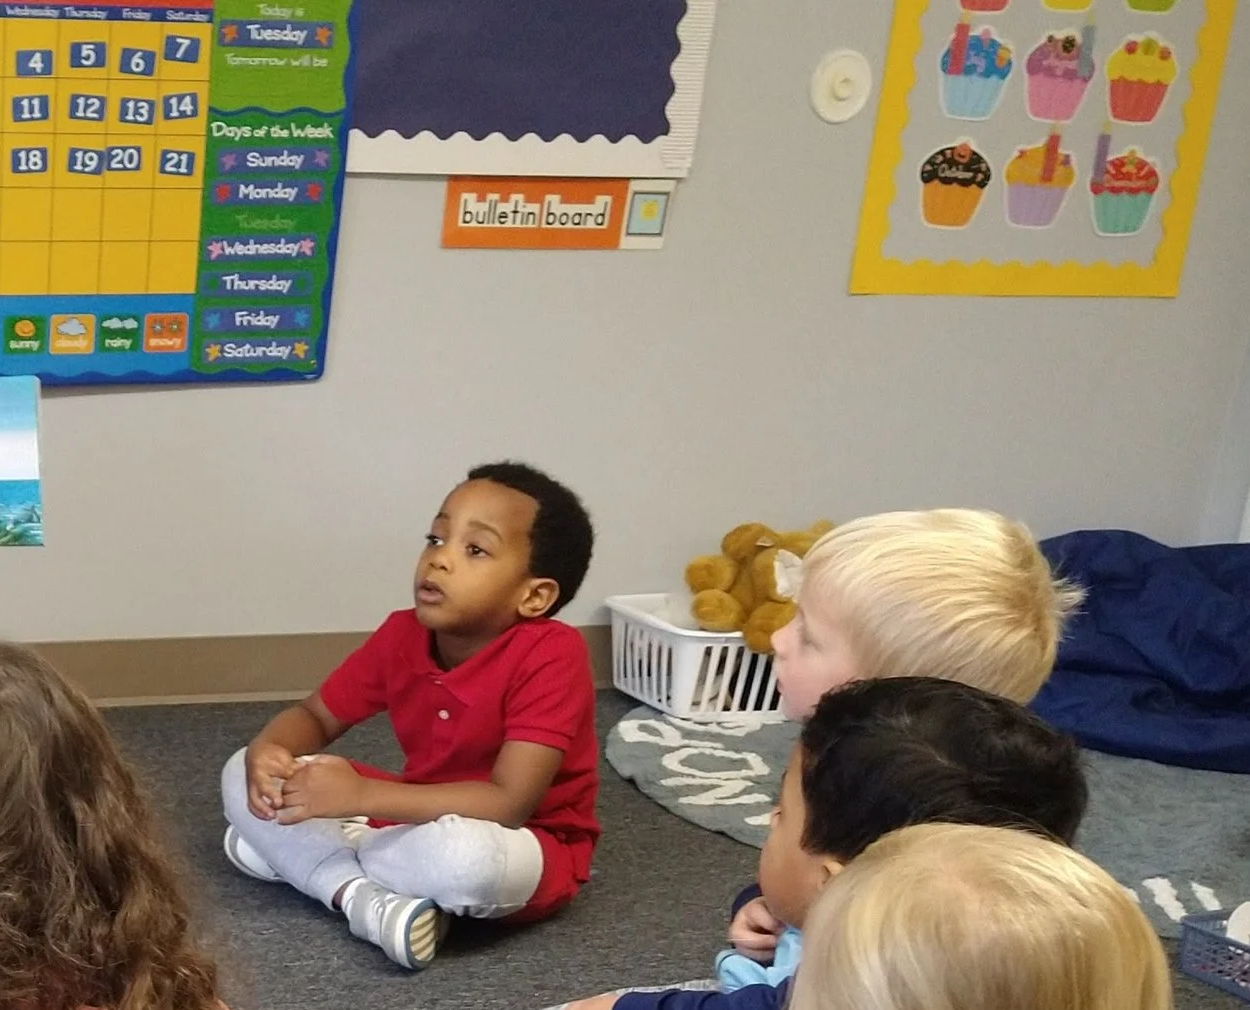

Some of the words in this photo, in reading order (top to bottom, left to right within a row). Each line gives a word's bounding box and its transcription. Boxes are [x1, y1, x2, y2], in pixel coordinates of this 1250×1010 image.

[64, 7, 109, 20] Thursday
[122, 8, 153, 21] Friday
[165, 9, 210, 23] Saturday
[258, 4, 292, 18] Today
[246, 24, 308, 45] Tuesday
[27, 52, 45, 74] 4
[80, 45, 97, 66] 5
[130, 51, 146, 73] 6
[175, 38, 192, 59] 7
[225, 53, 287, 66] Tomorrow
[291, 54, 312, 67] will
[312, 56, 329, 67] be
[20, 97, 43, 119] 11
[75, 96, 101, 119] 12
[124, 99, 150, 122] 13
[168, 95, 194, 118] 14
[211, 121, 251, 141] Days
[253, 126, 269, 138] of
[270, 124, 290, 138] the
[291, 122, 335, 139] Week
[17, 149, 43, 171] 18
[73, 150, 99, 173] 19
[109, 148, 139, 169] 20
[163, 152, 189, 174] 21
[246, 150, 306, 170] Sunday
[238, 182, 299, 202] Monday
[461, 197, 537, 225] bulletin
[545, 197, 609, 226] board
[222, 238, 301, 257] Wednesday
[222, 273, 293, 293] Thursday
[235, 310, 280, 329] Friday
[9, 339, 41, 351] sunny
[104, 337, 133, 350] rainy
[223, 341, 293, 359] Saturday
